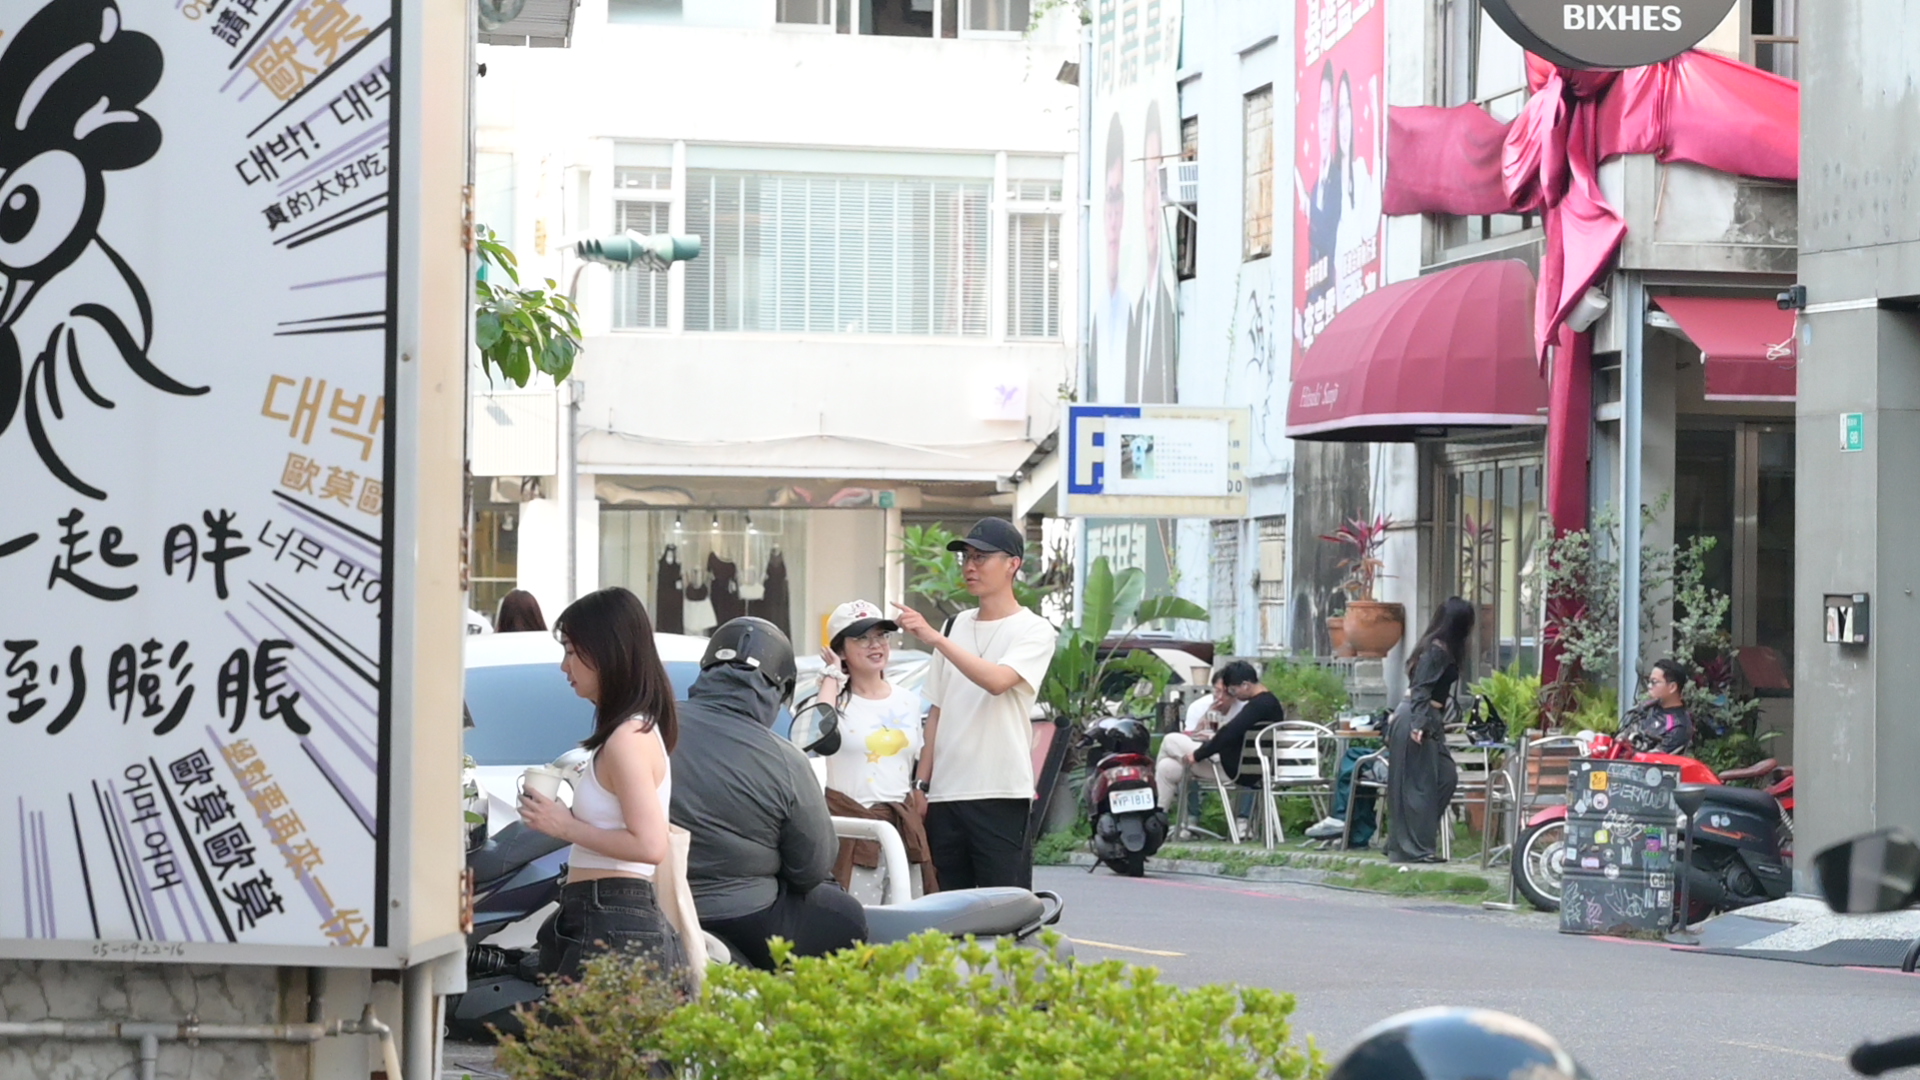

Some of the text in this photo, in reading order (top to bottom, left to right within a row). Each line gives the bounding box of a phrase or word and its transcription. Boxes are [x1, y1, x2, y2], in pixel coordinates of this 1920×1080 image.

[1563, 4, 1682, 31] BIXHES
[235, 121, 320, 186] 대박!
[261, 374, 386, 462] 대박
[257, 519, 325, 574] 너무
[4, 637, 311, 736] 到膨脹
[123, 763, 183, 892] 어머 어머
[168, 748, 286, 932] 歐莫歐莫
